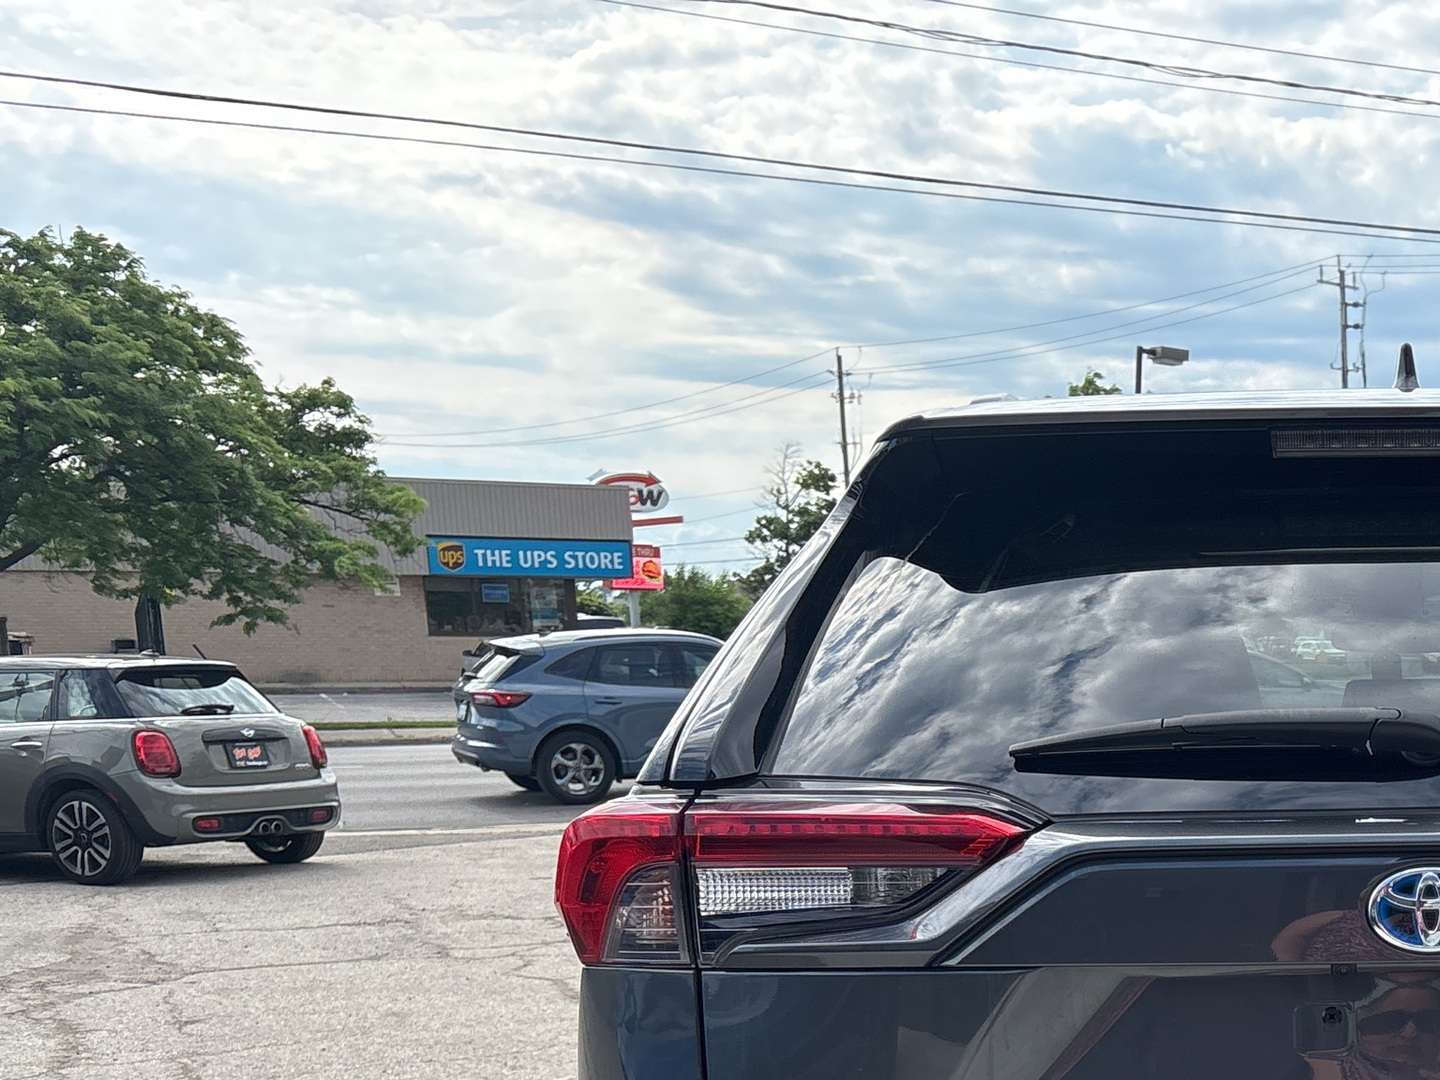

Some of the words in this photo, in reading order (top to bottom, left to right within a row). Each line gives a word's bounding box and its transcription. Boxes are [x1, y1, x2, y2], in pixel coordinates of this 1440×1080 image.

[440, 547, 464, 568] ups
[474, 549, 512, 568] THE
[519, 550, 558, 569] UPS
[564, 551, 624, 570] STORE
